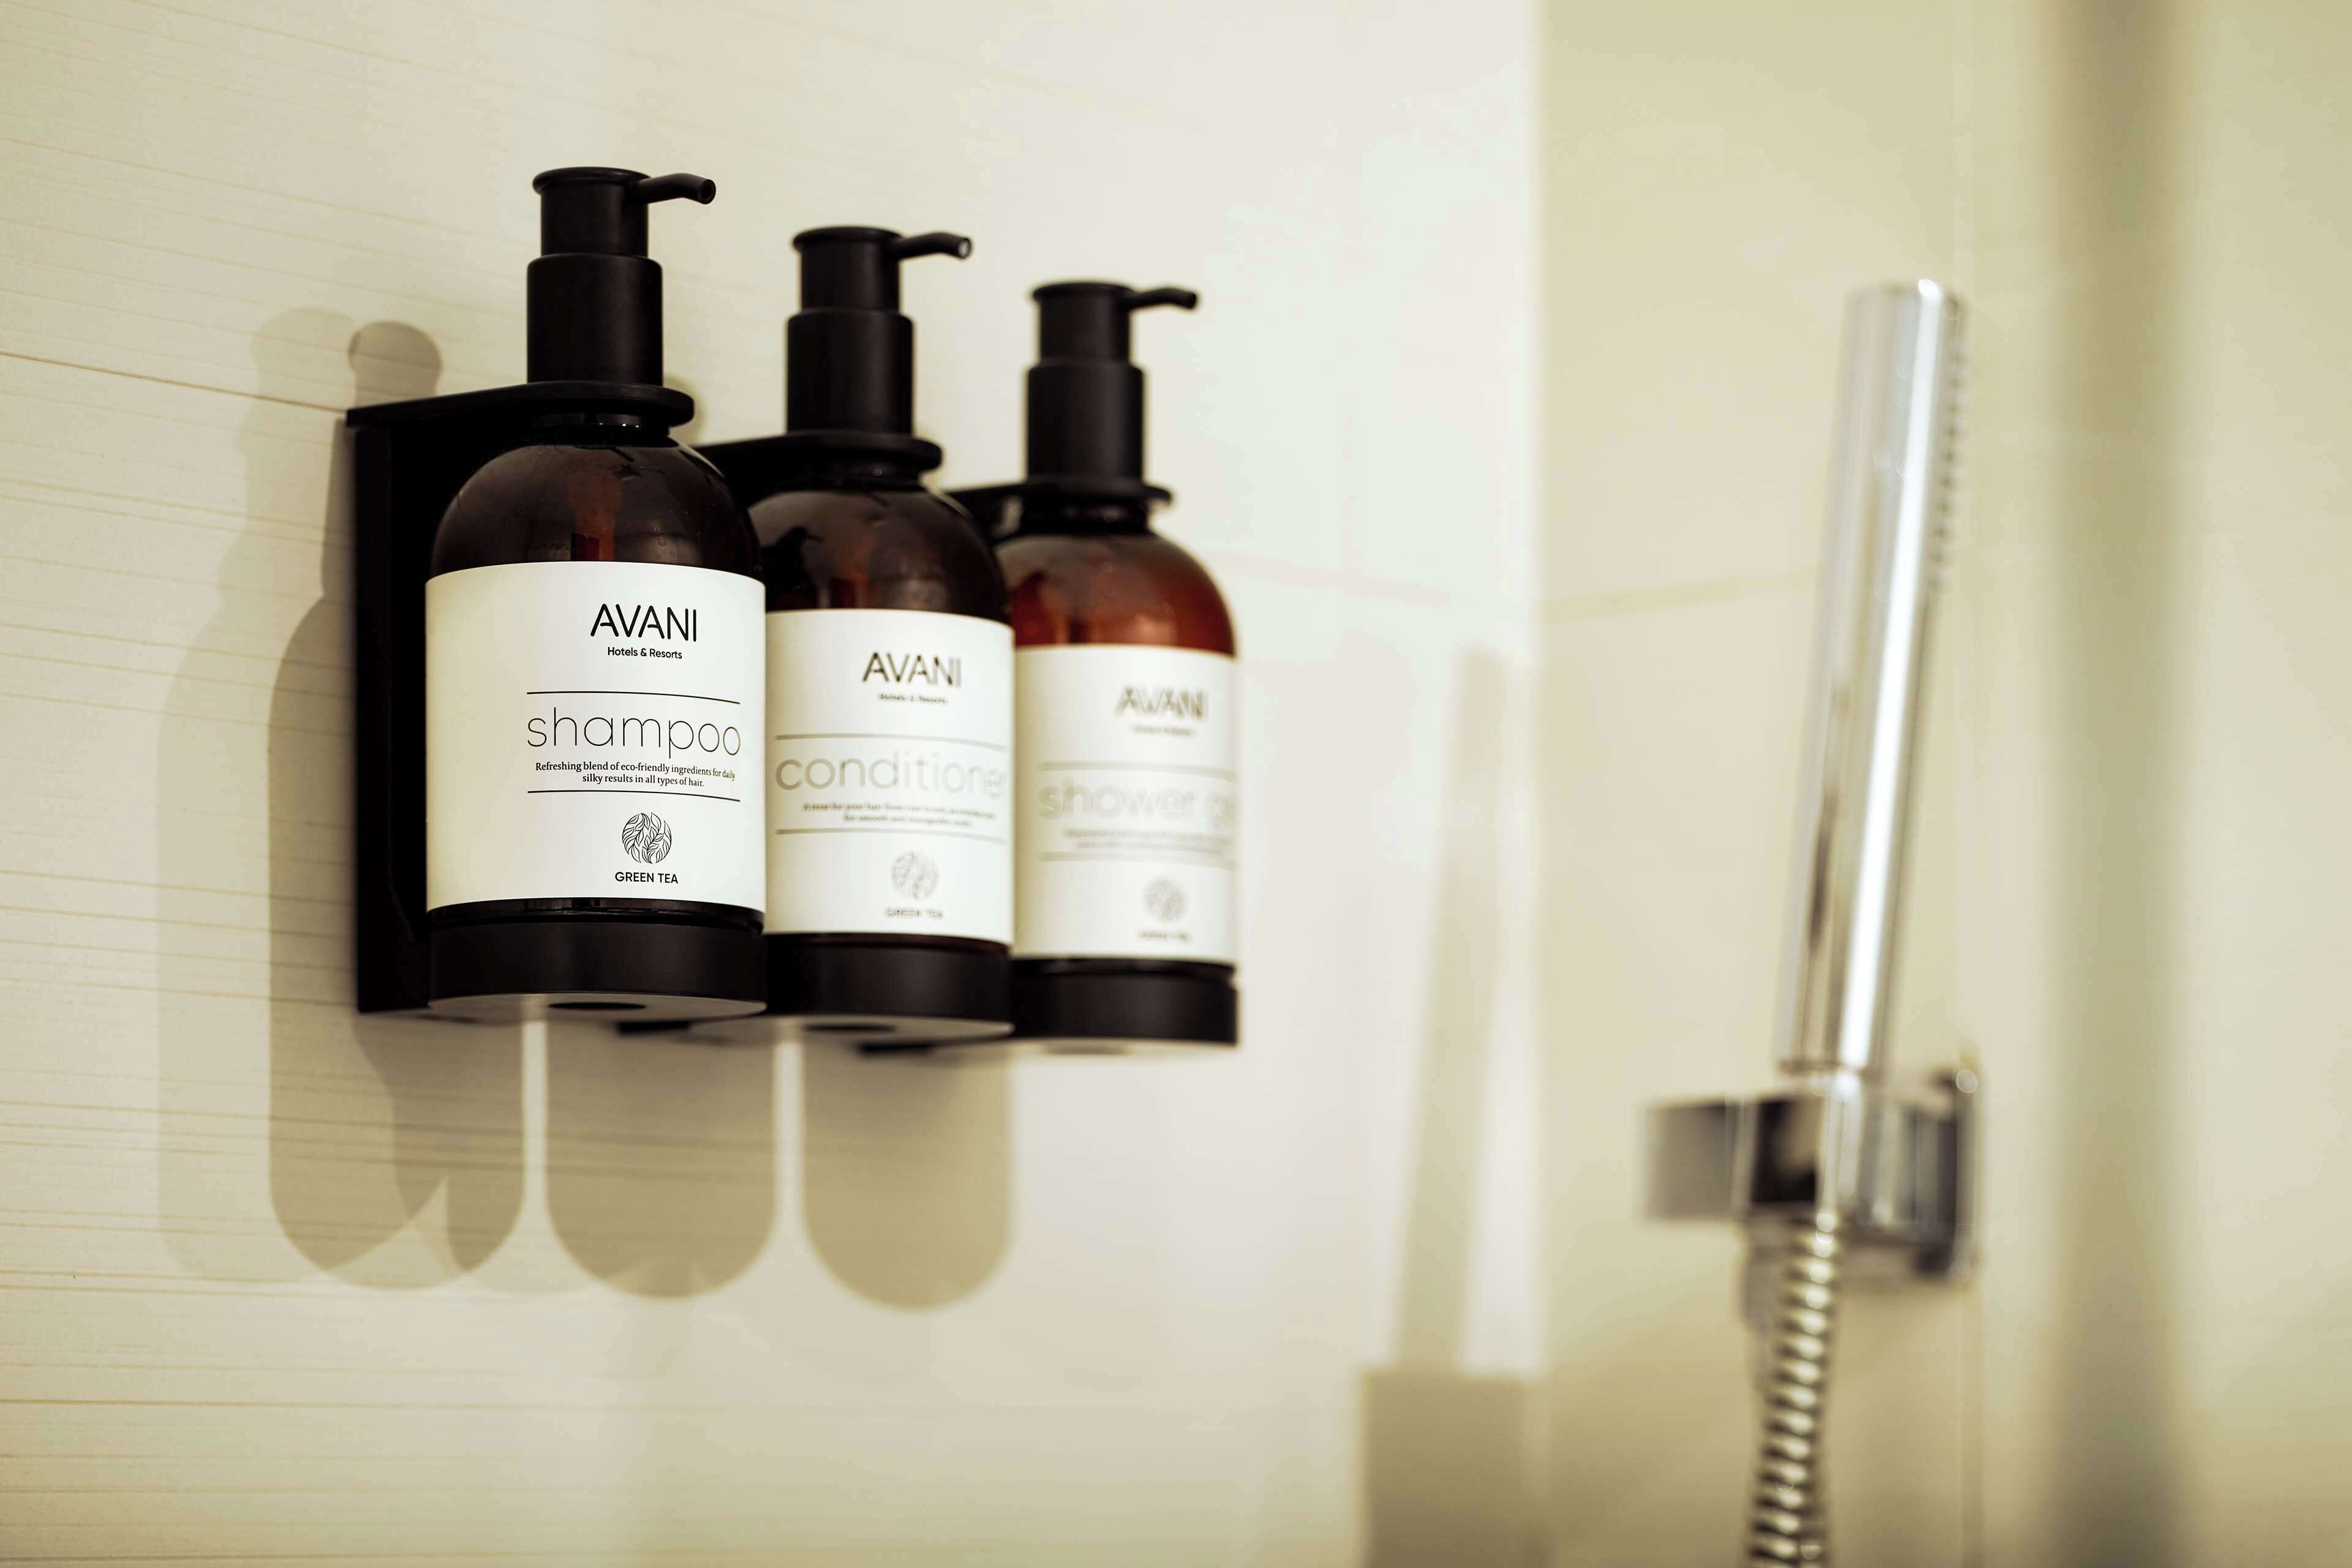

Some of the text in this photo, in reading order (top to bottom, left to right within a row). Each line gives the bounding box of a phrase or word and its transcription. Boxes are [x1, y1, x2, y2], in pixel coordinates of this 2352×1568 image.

[590, 603, 697, 643] AVANI
[607, 646, 683, 660] Hotels & Resorts
[861, 651, 962, 688] AVANI
[527, 706, 741, 759] shampoo
[535, 761, 582, 773] Refreshing
[583, 761, 608, 771] blend
[610, 761, 620, 771] of
[620, 763, 669, 775] eco-friendly
[671, 764, 712, 776] ingredients
[712, 767, 721, 777] for
[582, 773, 603, 785] silky
[604, 774, 633, 783] results
[645, 775, 655, 783] all
[657, 777, 678, 786] types
[679, 777, 687, 786] of
[688, 777, 704, 787] hair.
[614, 871, 679, 884] GREEN TEA
